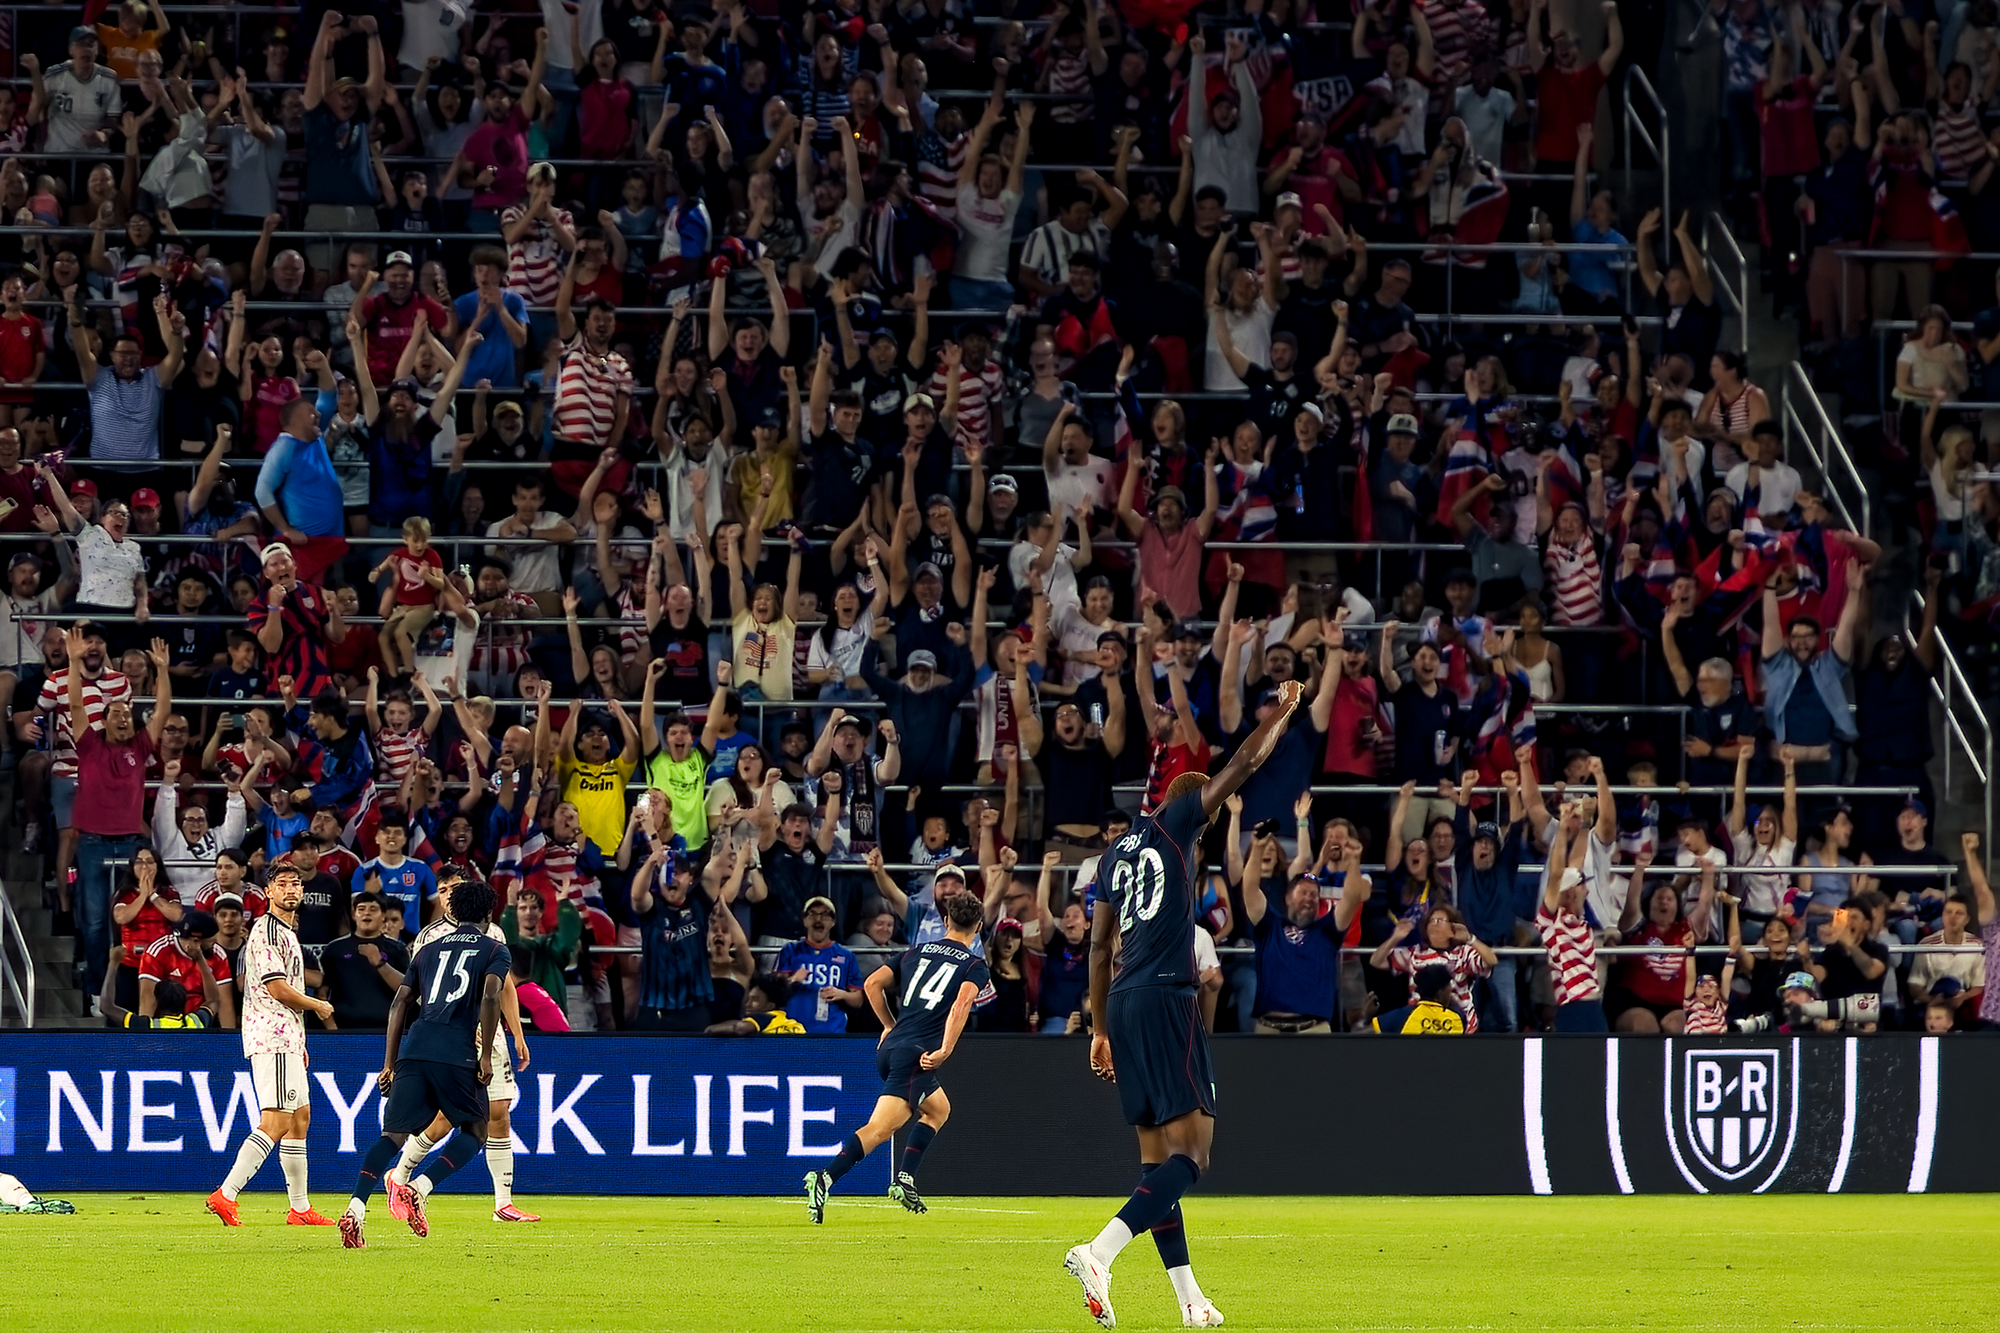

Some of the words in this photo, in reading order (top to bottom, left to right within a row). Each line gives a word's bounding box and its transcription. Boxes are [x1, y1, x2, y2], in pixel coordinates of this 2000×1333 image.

[580, 778, 614, 792] bwin
[1111, 847, 1166, 933] 20
[920, 943, 970, 962] BERHALTER
[427, 949, 481, 1004] 15
[801, 963, 844, 987] USA
[902, 957, 960, 1011] 14
[1421, 1018, 1454, 1032] CSC
[45, 1070, 263, 1153] NEW
[312, 1071, 607, 1155] YK
[631, 1074, 844, 1157] LIFE
